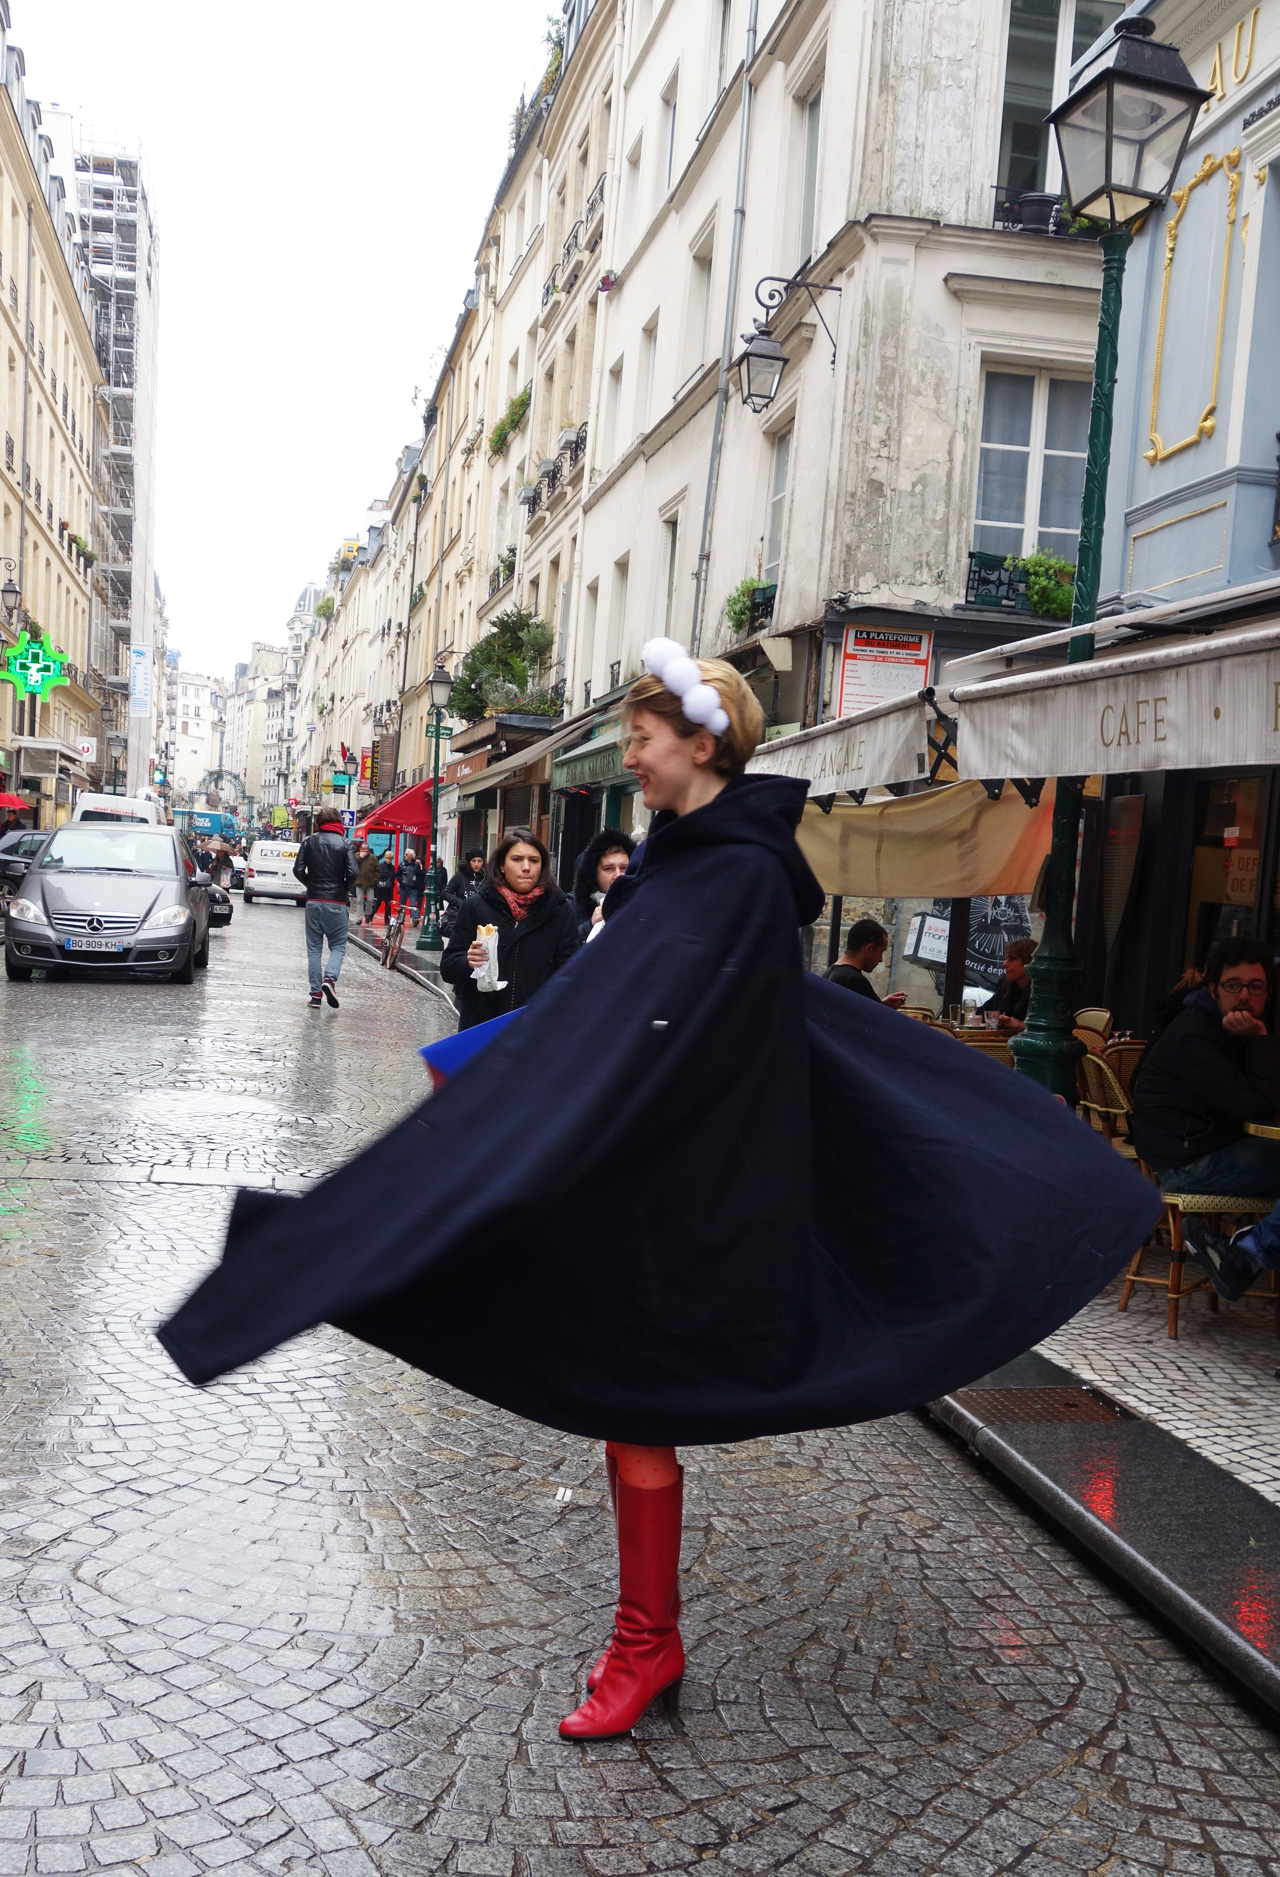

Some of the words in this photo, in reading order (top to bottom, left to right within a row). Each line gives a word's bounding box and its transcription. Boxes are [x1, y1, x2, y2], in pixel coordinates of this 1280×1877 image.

[1202, 7, 1260, 113] AU
[857, 631, 867, 639] LA
[869, 632, 920, 643] PLATEFORME
[876, 641, 911, 649] BATIMENT
[884, 656, 916, 664] CONSTRUIRE
[1100, 696, 1168, 748] CAFE
[81, 745, 90, 753] U
[813, 740, 866, 780] CANCALE
[565, 764, 577, 783] BAR
[588, 752, 616, 779] SALADES
[402, 824, 418, 834] Italy
[261, 849, 280, 857] FLY
[1231, 877, 1246, 893] DE
[71, 939, 117, 949] BQ-909-KH
[964, 959, 986, 972] ortié
